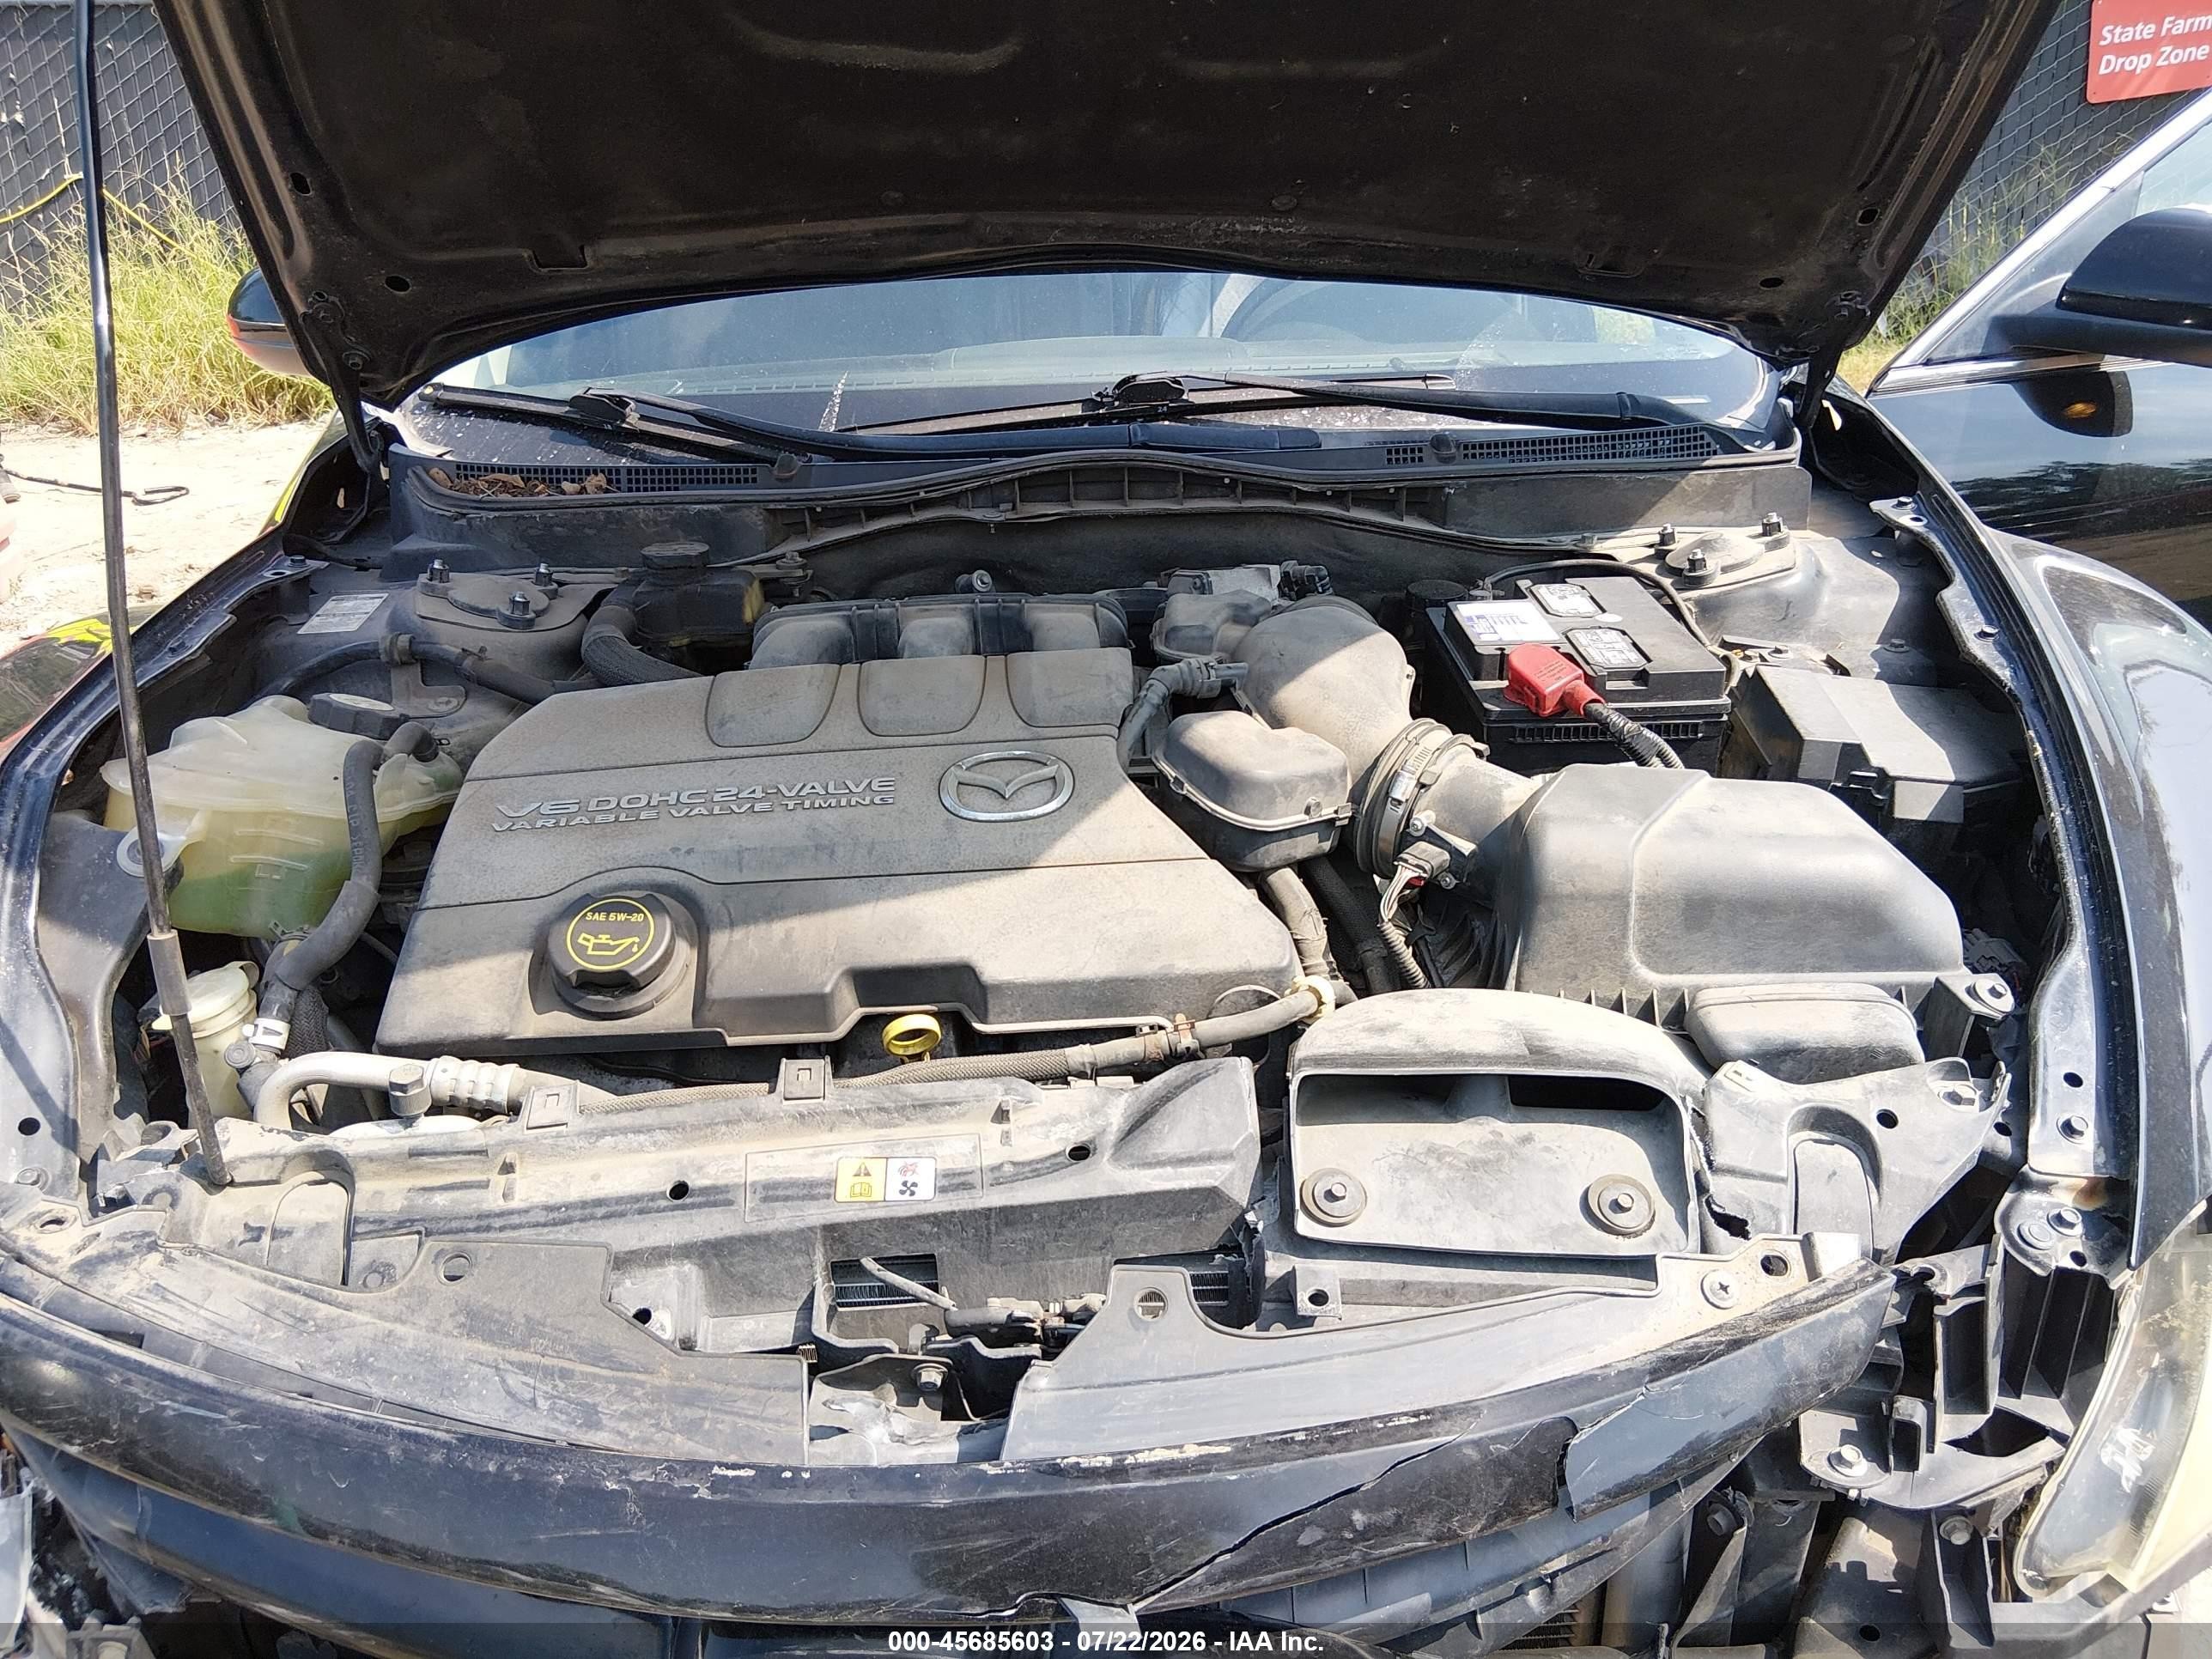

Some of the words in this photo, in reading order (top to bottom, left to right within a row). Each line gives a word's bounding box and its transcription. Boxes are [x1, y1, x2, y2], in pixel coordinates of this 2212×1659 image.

[2099, 21, 2156, 46] State
[2160, 15, 2212, 37] Farm
[2098, 52, 2152, 76] Drop
[2155, 45, 2210, 67] Zone
[496, 799, 580, 817] V6
[586, 788, 708, 811] DOHC
[712, 776, 896, 804] 24-VALVE
[491, 809, 660, 832] VARIABLE
[669, 802, 773, 817] VALVE
[781, 795, 895, 811] TIMING
[586, 912, 606, 921] SAE
[609, 913, 644, 921] 5W-20
